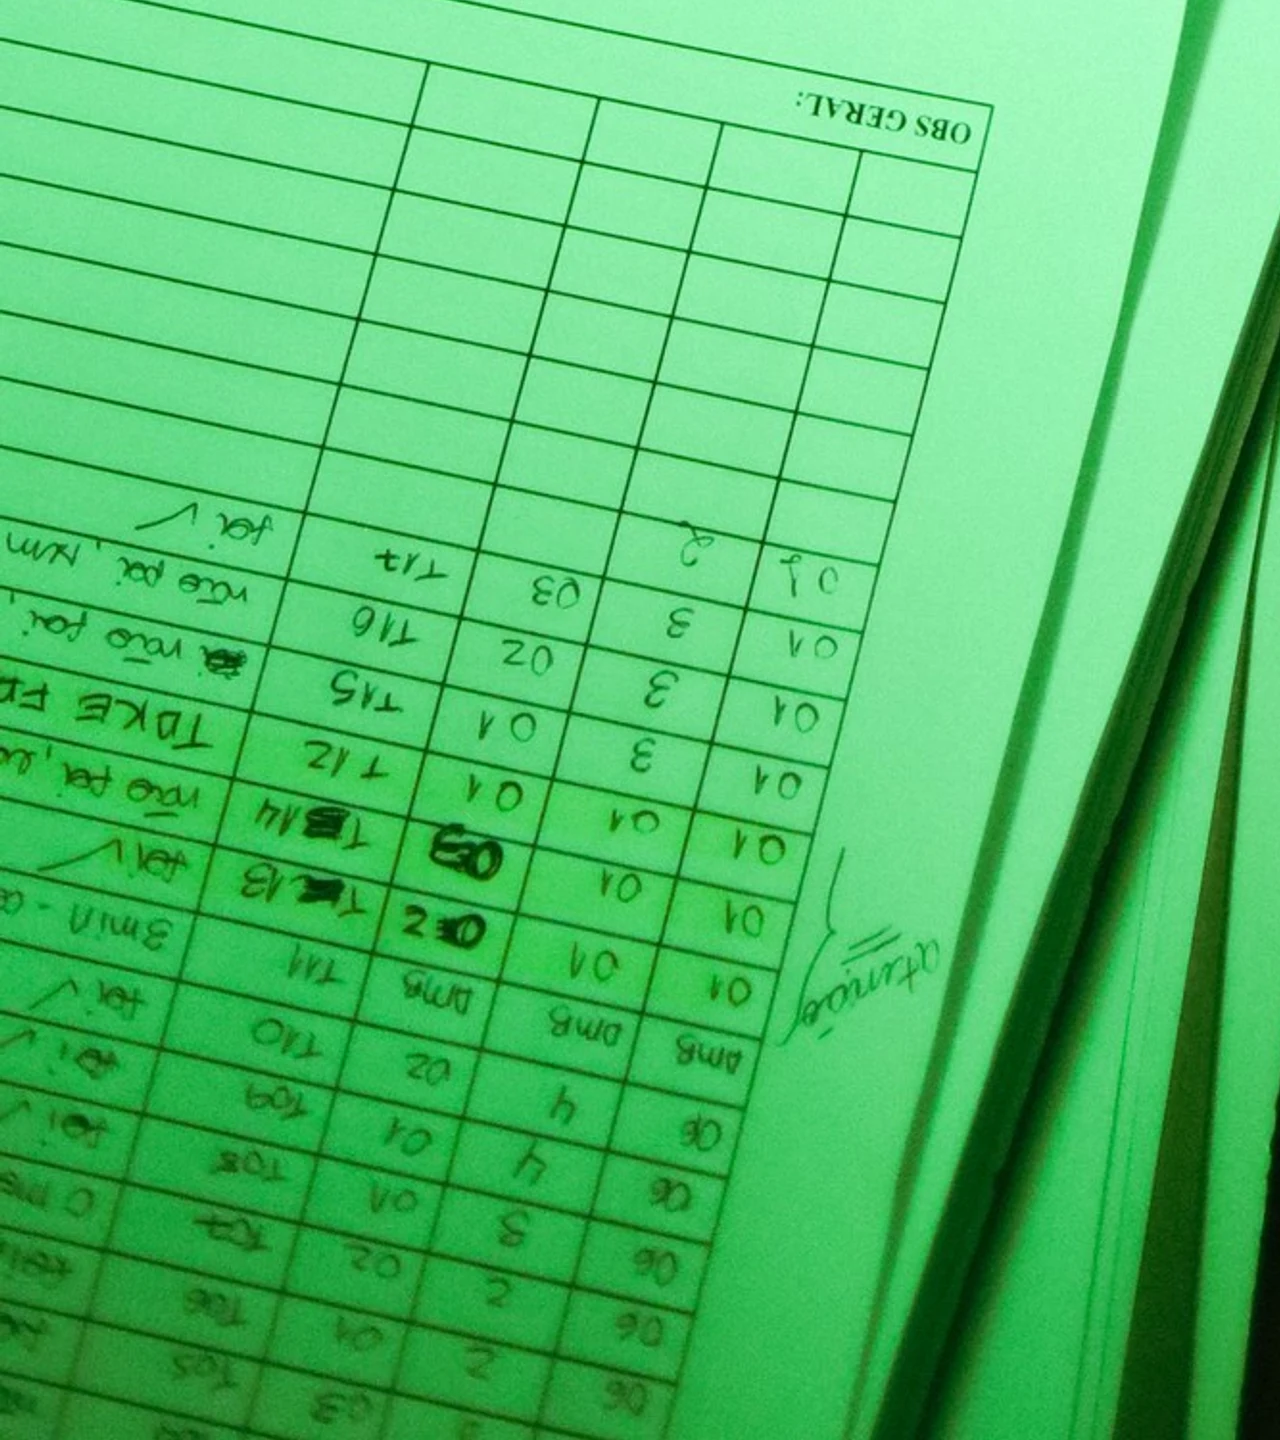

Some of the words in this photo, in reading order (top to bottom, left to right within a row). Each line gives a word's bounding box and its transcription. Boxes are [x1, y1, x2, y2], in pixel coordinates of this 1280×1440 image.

[795, 92, 907, 133] GERAL:
[914, 114, 972, 145] OBS
[207, 512, 273, 550] foi
[678, 520, 715, 567] 2
[375, 548, 448, 583] T17
[780, 553, 838, 599] 01
[178, 573, 247, 605] não
[532, 576, 580, 610] 03
[352, 606, 418, 647] T16
[666, 607, 694, 639] 3
[106, 628, 182, 666] não
[501, 639, 553, 675] 02
[788, 628, 838, 660] 01
[329, 670, 403, 714] T15
[643, 671, 679, 709] 3
[478, 711, 535, 742] 01
[773, 695, 819, 734] 01
[629, 739, 655, 772] 3
[126, 778, 199, 819] não
[467, 773, 524, 813] 01
[753, 765, 801, 800] 01
[610, 808, 659, 834] 01
[734, 829, 785, 865] 01
[602, 869, 641, 903] 01
[724, 901, 763, 938] 01
[287, 944, 343, 986] T11
[570, 942, 619, 983] 01
[710, 976, 751, 1008] 01
[251, 1017, 321, 1060] T10
[405, 1051, 450, 1082] 02
[245, 1081, 310, 1121] T09
[549, 1085, 576, 1125] 4
[385, 1116, 432, 1156] 01
[680, 1116, 722, 1152] 06
[512, 1145, 547, 1188] 4
[369, 1182, 418, 1213] 01
[649, 1177, 693, 1212] 06
[498, 1209, 530, 1248] 3
[633, 1247, 678, 1288] 06
[485, 1277, 513, 1309] 2
[615, 1310, 663, 1347] 06
